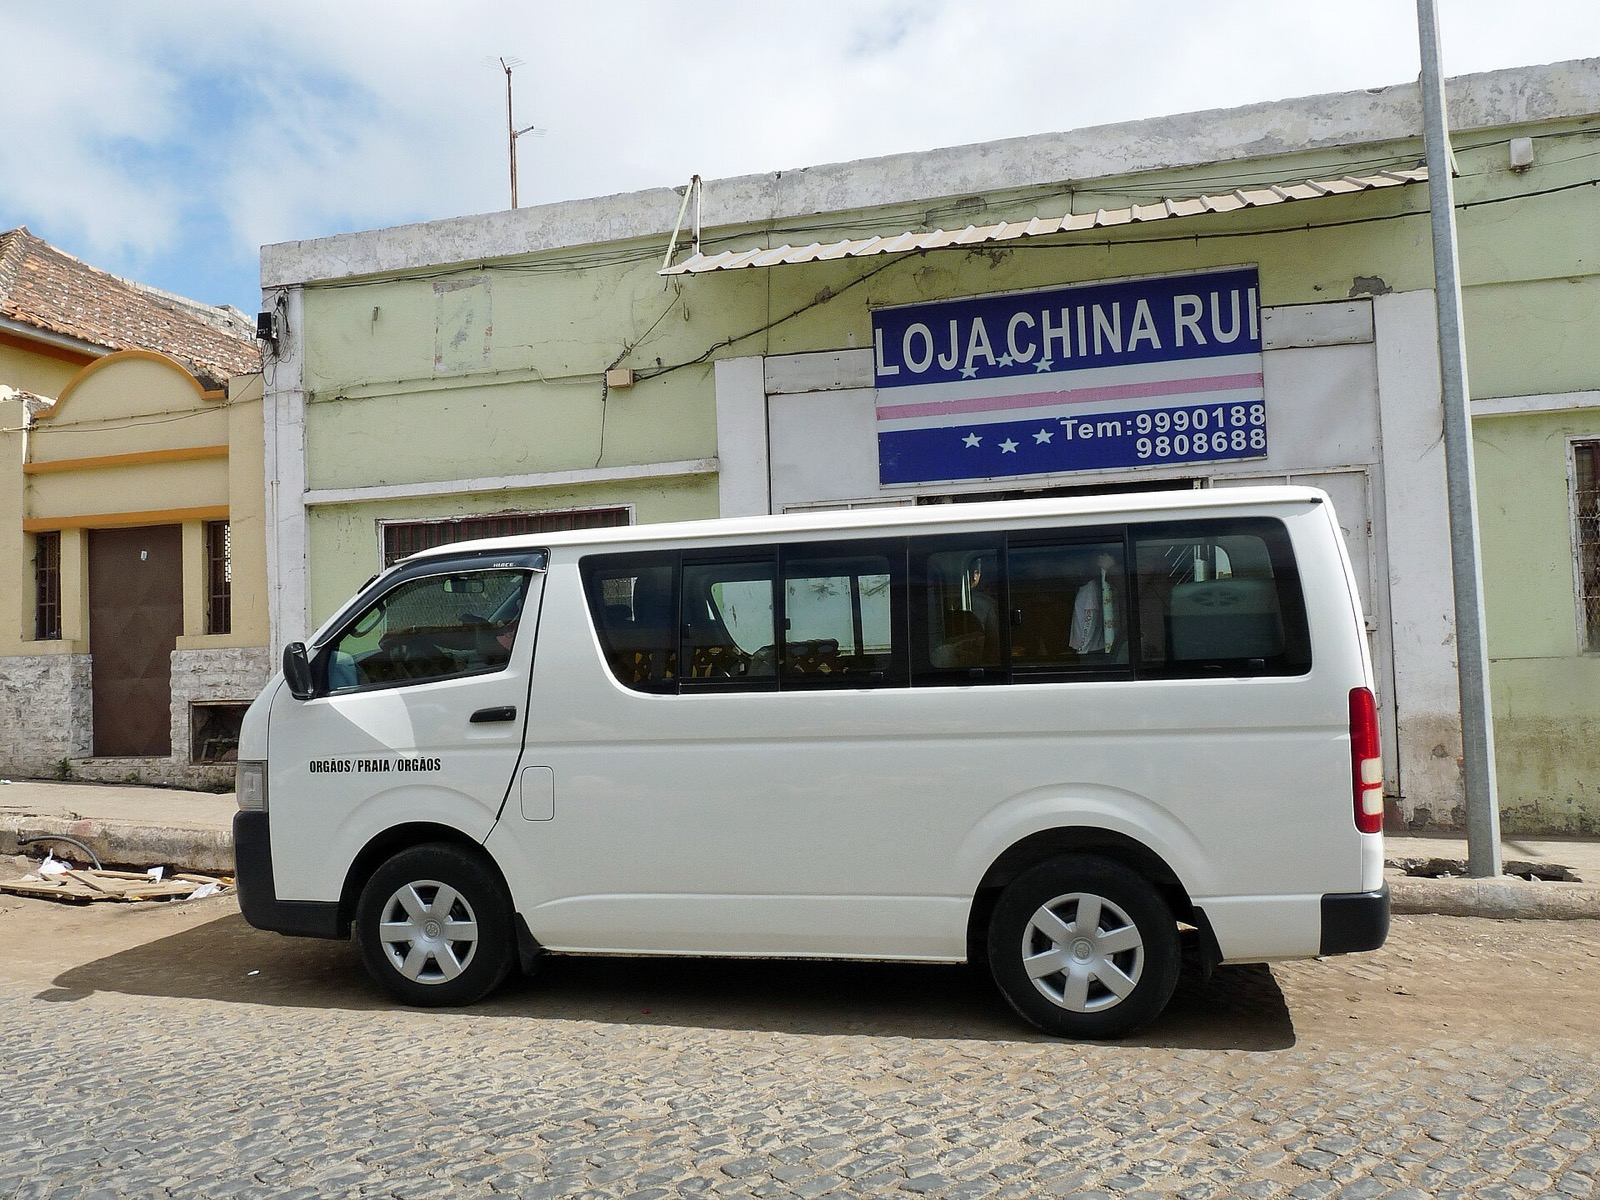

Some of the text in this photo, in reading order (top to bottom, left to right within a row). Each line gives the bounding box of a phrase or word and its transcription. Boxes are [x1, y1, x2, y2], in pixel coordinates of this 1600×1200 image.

[875, 287, 1259, 376] LOJA CHINA RUI
[1136, 428, 1266, 458] 9808688
